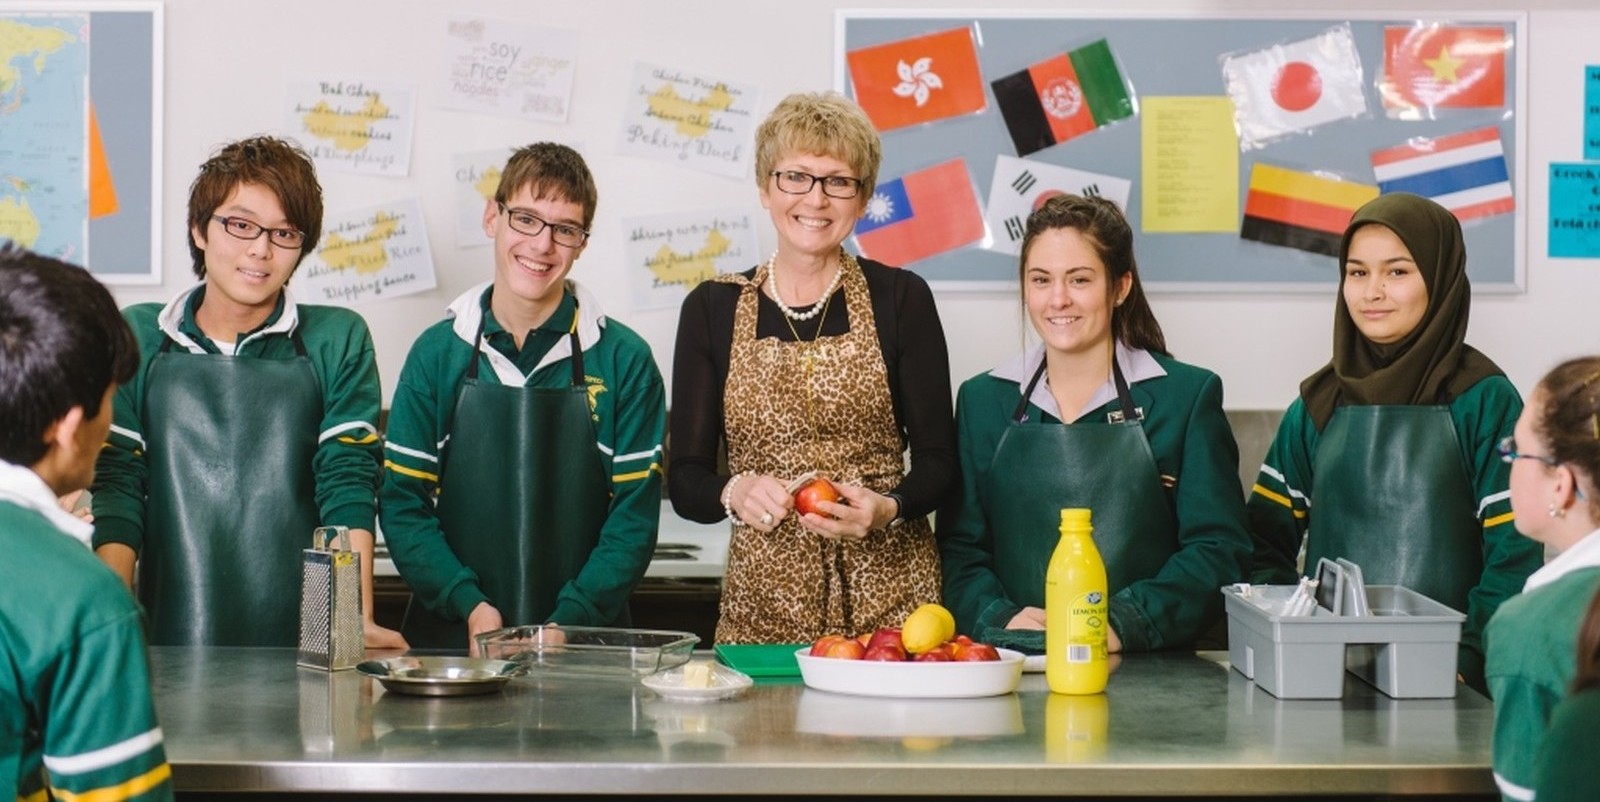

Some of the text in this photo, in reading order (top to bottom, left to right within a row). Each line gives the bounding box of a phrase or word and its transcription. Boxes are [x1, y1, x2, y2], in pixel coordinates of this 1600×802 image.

[489, 42, 522, 69] soy
[470, 62, 508, 82] rice
[346, 83, 380, 104] Choy
[452, 81, 499, 97] noodles
[686, 114, 734, 133] Chicken
[695, 138, 742, 162] Duck
[322, 280, 383, 300] Dipping
[1072, 608, 1097, 616] LEMON
